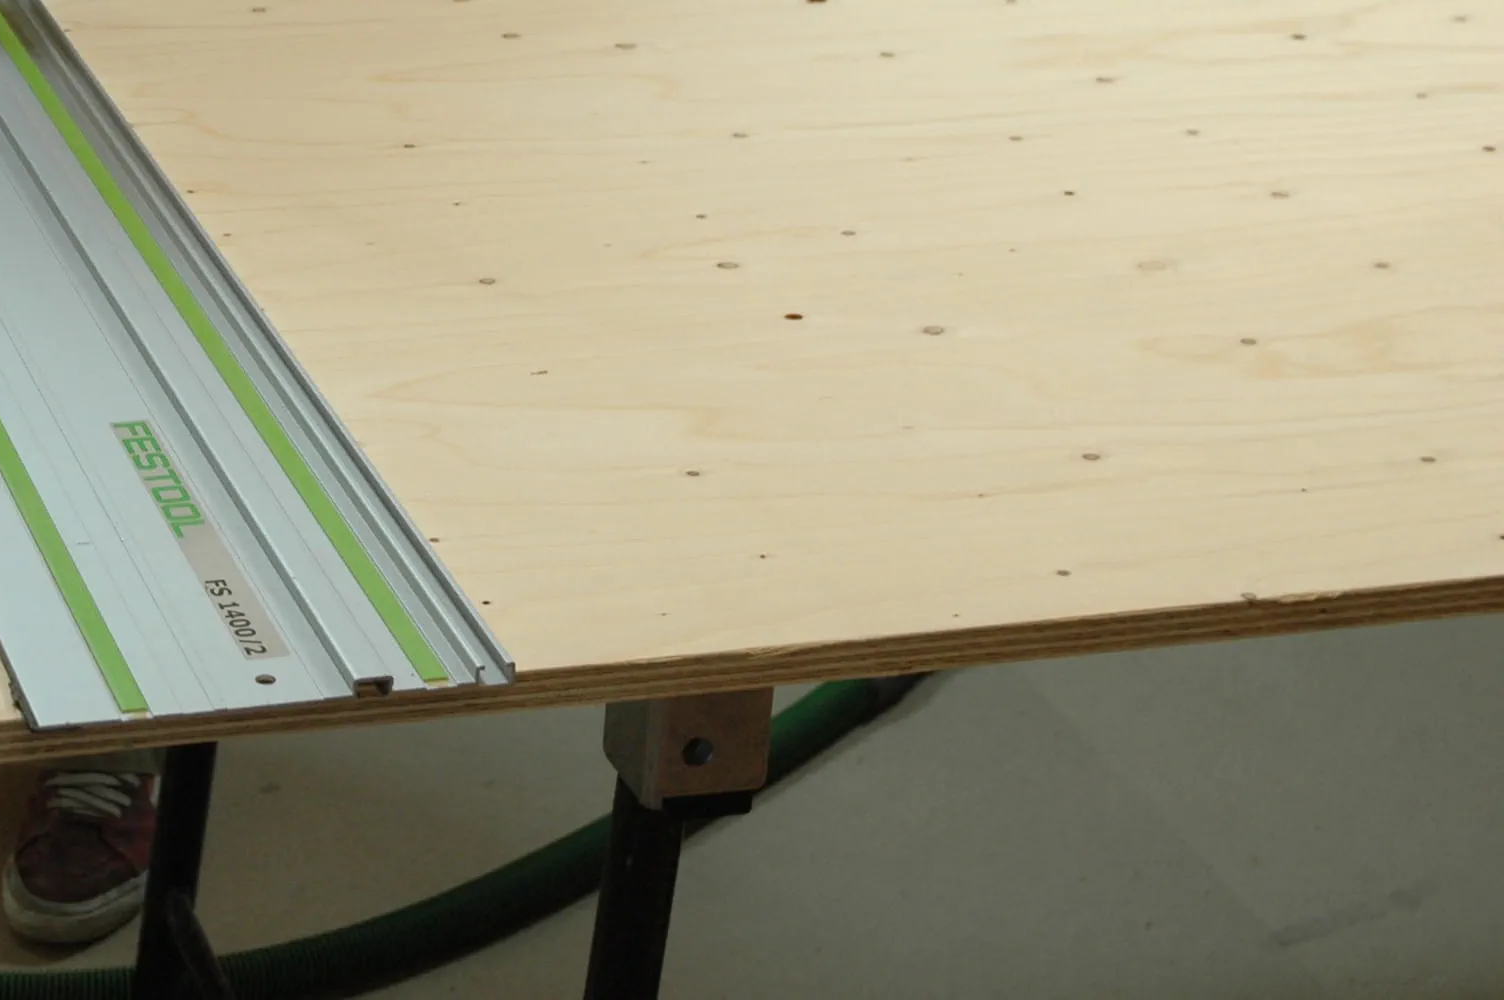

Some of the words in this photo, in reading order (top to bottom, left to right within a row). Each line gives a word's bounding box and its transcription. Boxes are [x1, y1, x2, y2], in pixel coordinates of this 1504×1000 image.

[108, 420, 206, 539] FESTOOL
[204, 578, 232, 598] FS
[218, 601, 268, 657] 1400/2
